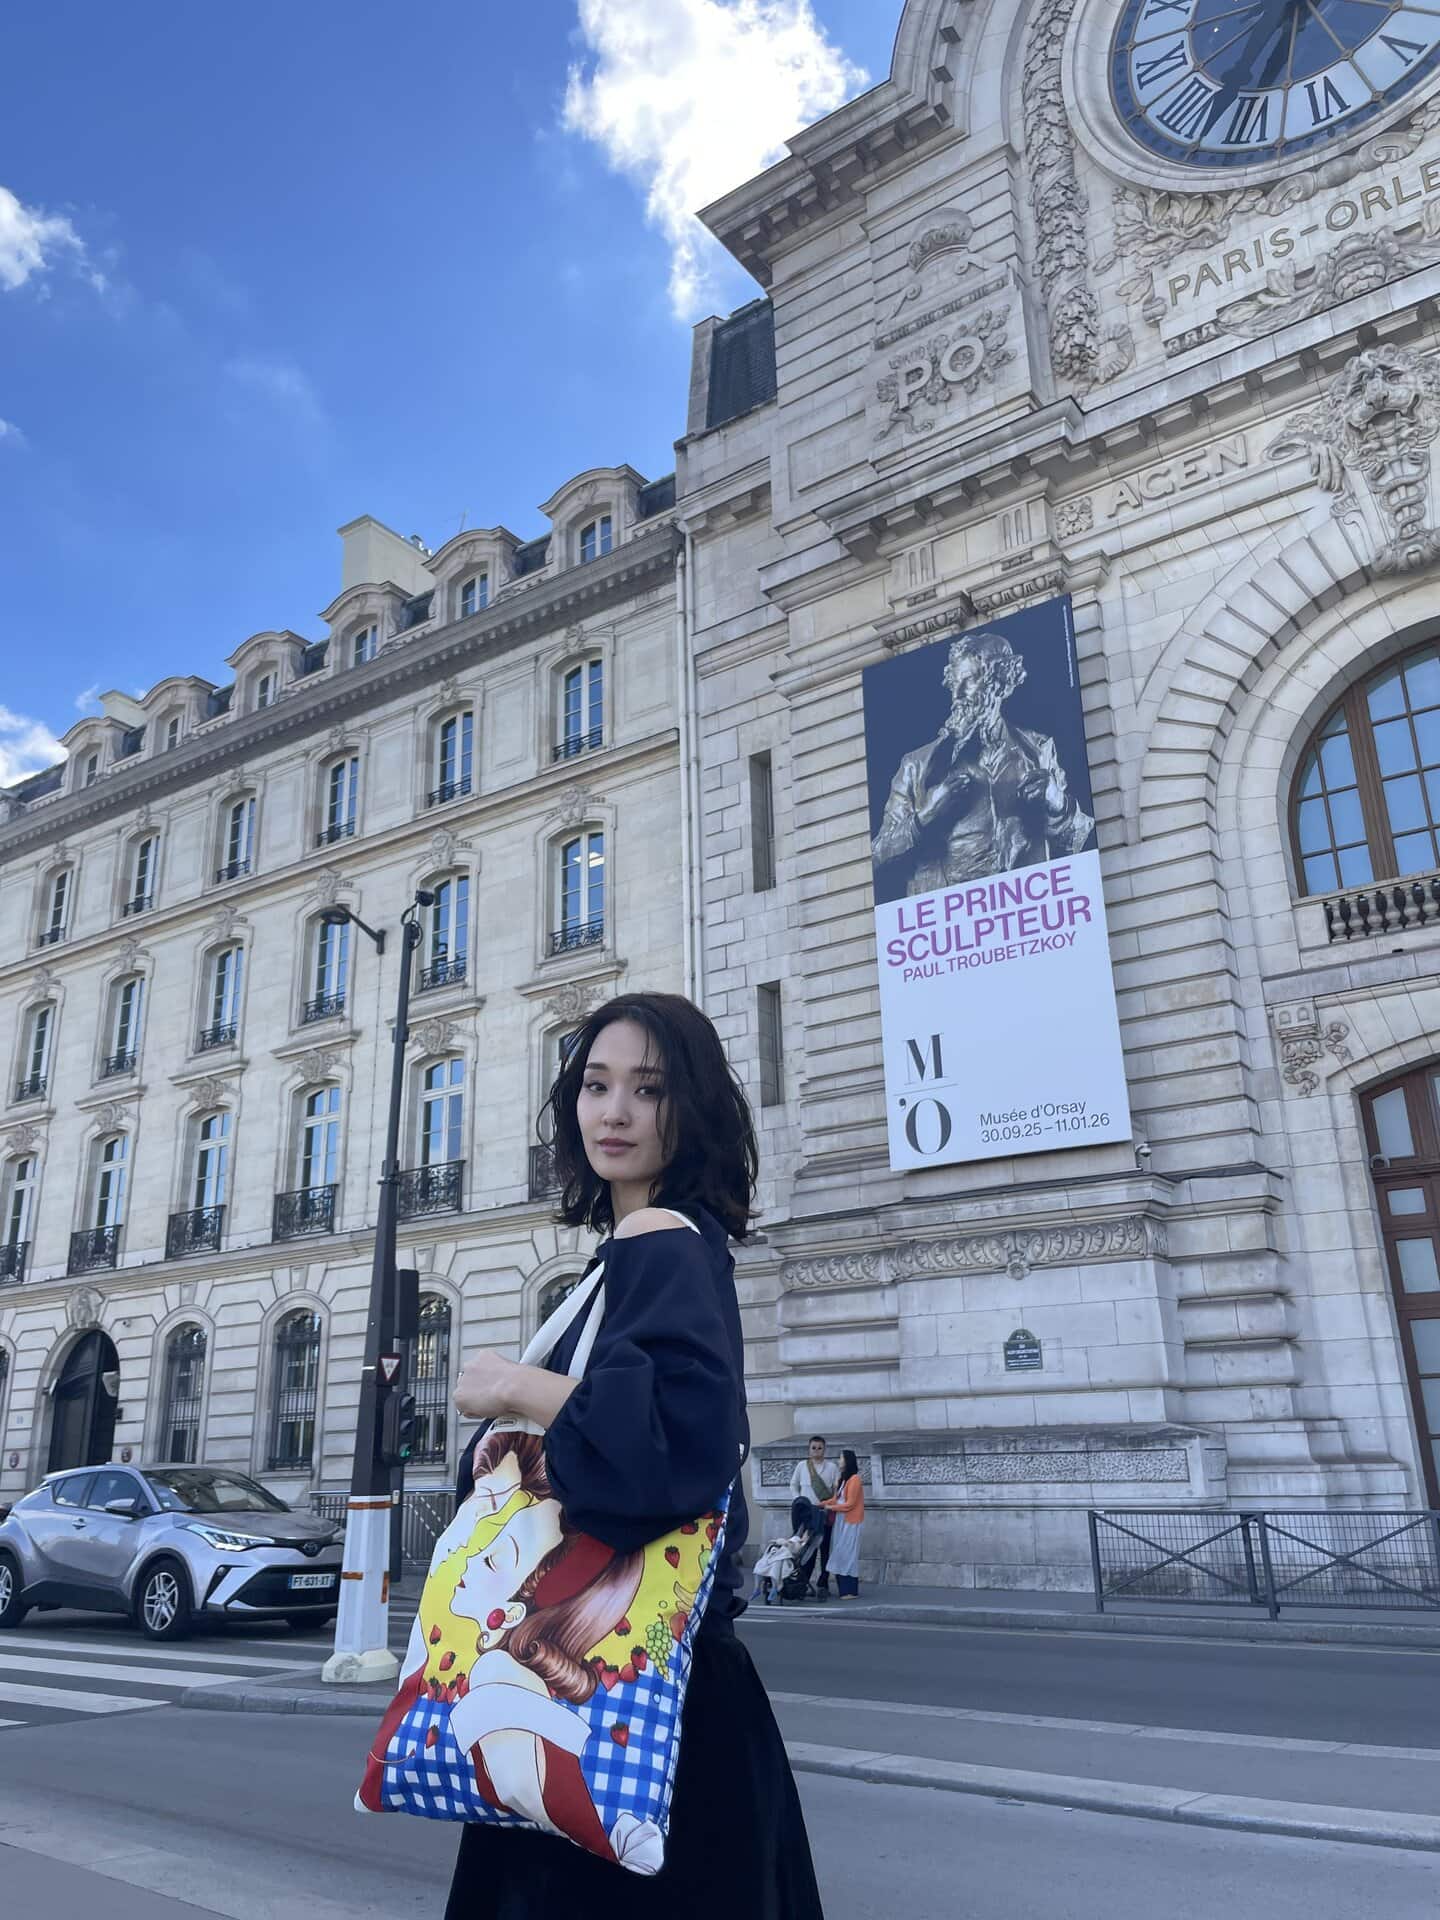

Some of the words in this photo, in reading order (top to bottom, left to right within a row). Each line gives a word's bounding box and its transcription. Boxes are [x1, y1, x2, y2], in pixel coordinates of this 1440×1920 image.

[1379, 34, 1428, 66] V
[1168, 157, 1440, 306] PARIS-ORLE
[896, 336, 985, 412] PO
[1107, 433, 1249, 518] AGEN
[886, 895, 1092, 967] SCULPTEUR
[897, 899, 936, 933] LE
[944, 864, 1074, 923] PRINCE
[903, 961, 945, 983] PAUL
[949, 931, 1076, 973] TROUBETZKOY
[904, 1033, 950, 1085] M
[979, 1108, 1028, 1127] Musée
[1031, 1101, 1087, 1119] d'Orsay
